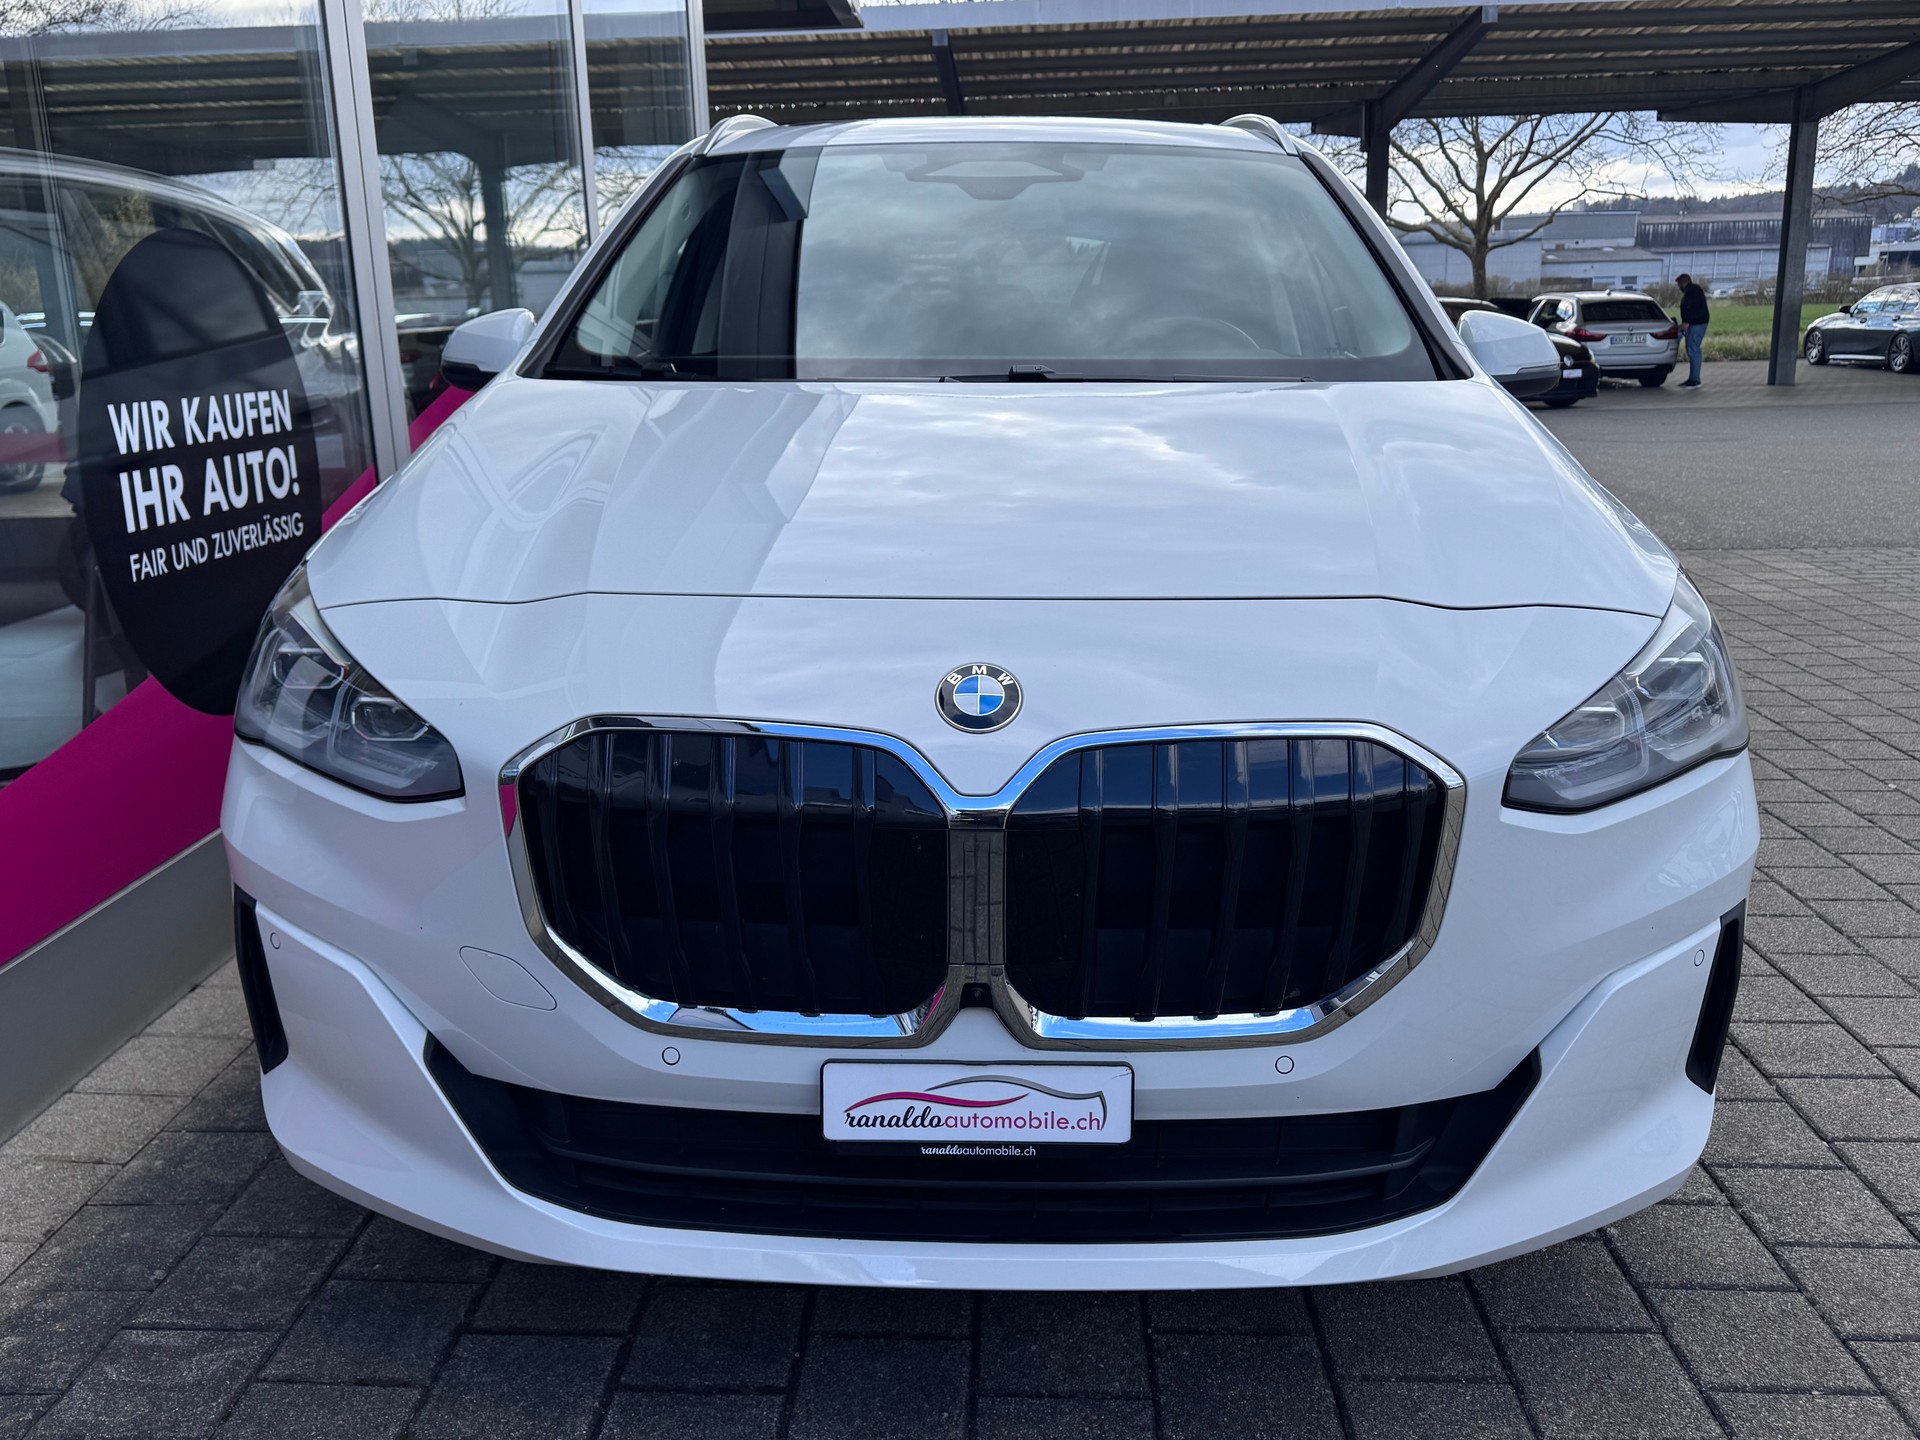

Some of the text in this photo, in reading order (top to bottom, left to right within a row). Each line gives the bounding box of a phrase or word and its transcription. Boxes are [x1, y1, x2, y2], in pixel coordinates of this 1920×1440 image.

[107, 388, 293, 456] WIR KAUFEN
[119, 444, 300, 534] IHR AUTO!
[129, 512, 304, 583] FAIR UND ZUVERLÄSSIG
[946, 665, 1014, 686] BMW
[844, 1105, 1101, 1131] ranaldoautomobile.ch
[920, 1144, 1036, 1157] ranaldoautomobile.ch
